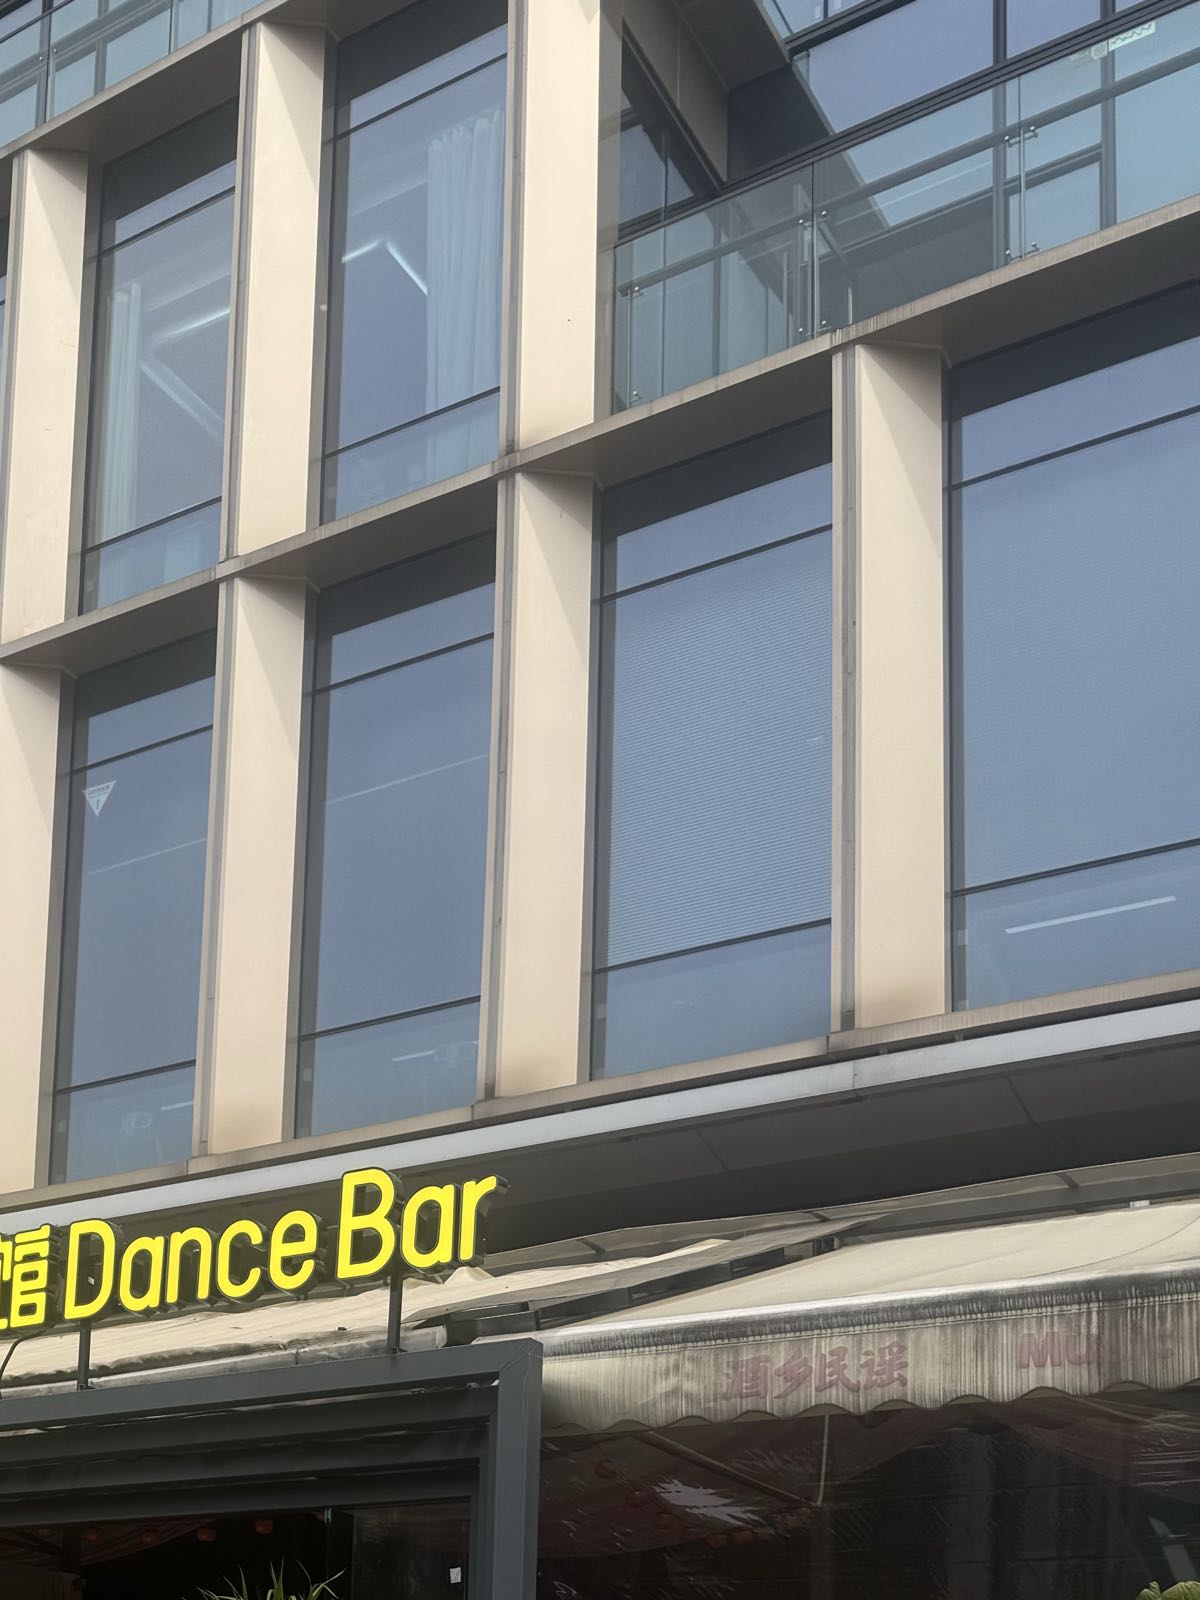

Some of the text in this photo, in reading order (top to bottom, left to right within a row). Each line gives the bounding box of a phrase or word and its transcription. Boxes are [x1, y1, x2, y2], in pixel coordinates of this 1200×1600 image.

[64, 1218, 315, 1321] Dance
[336, 1168, 498, 1280] Bar
[721, 1341, 909, 1400] 酒乡民谣
